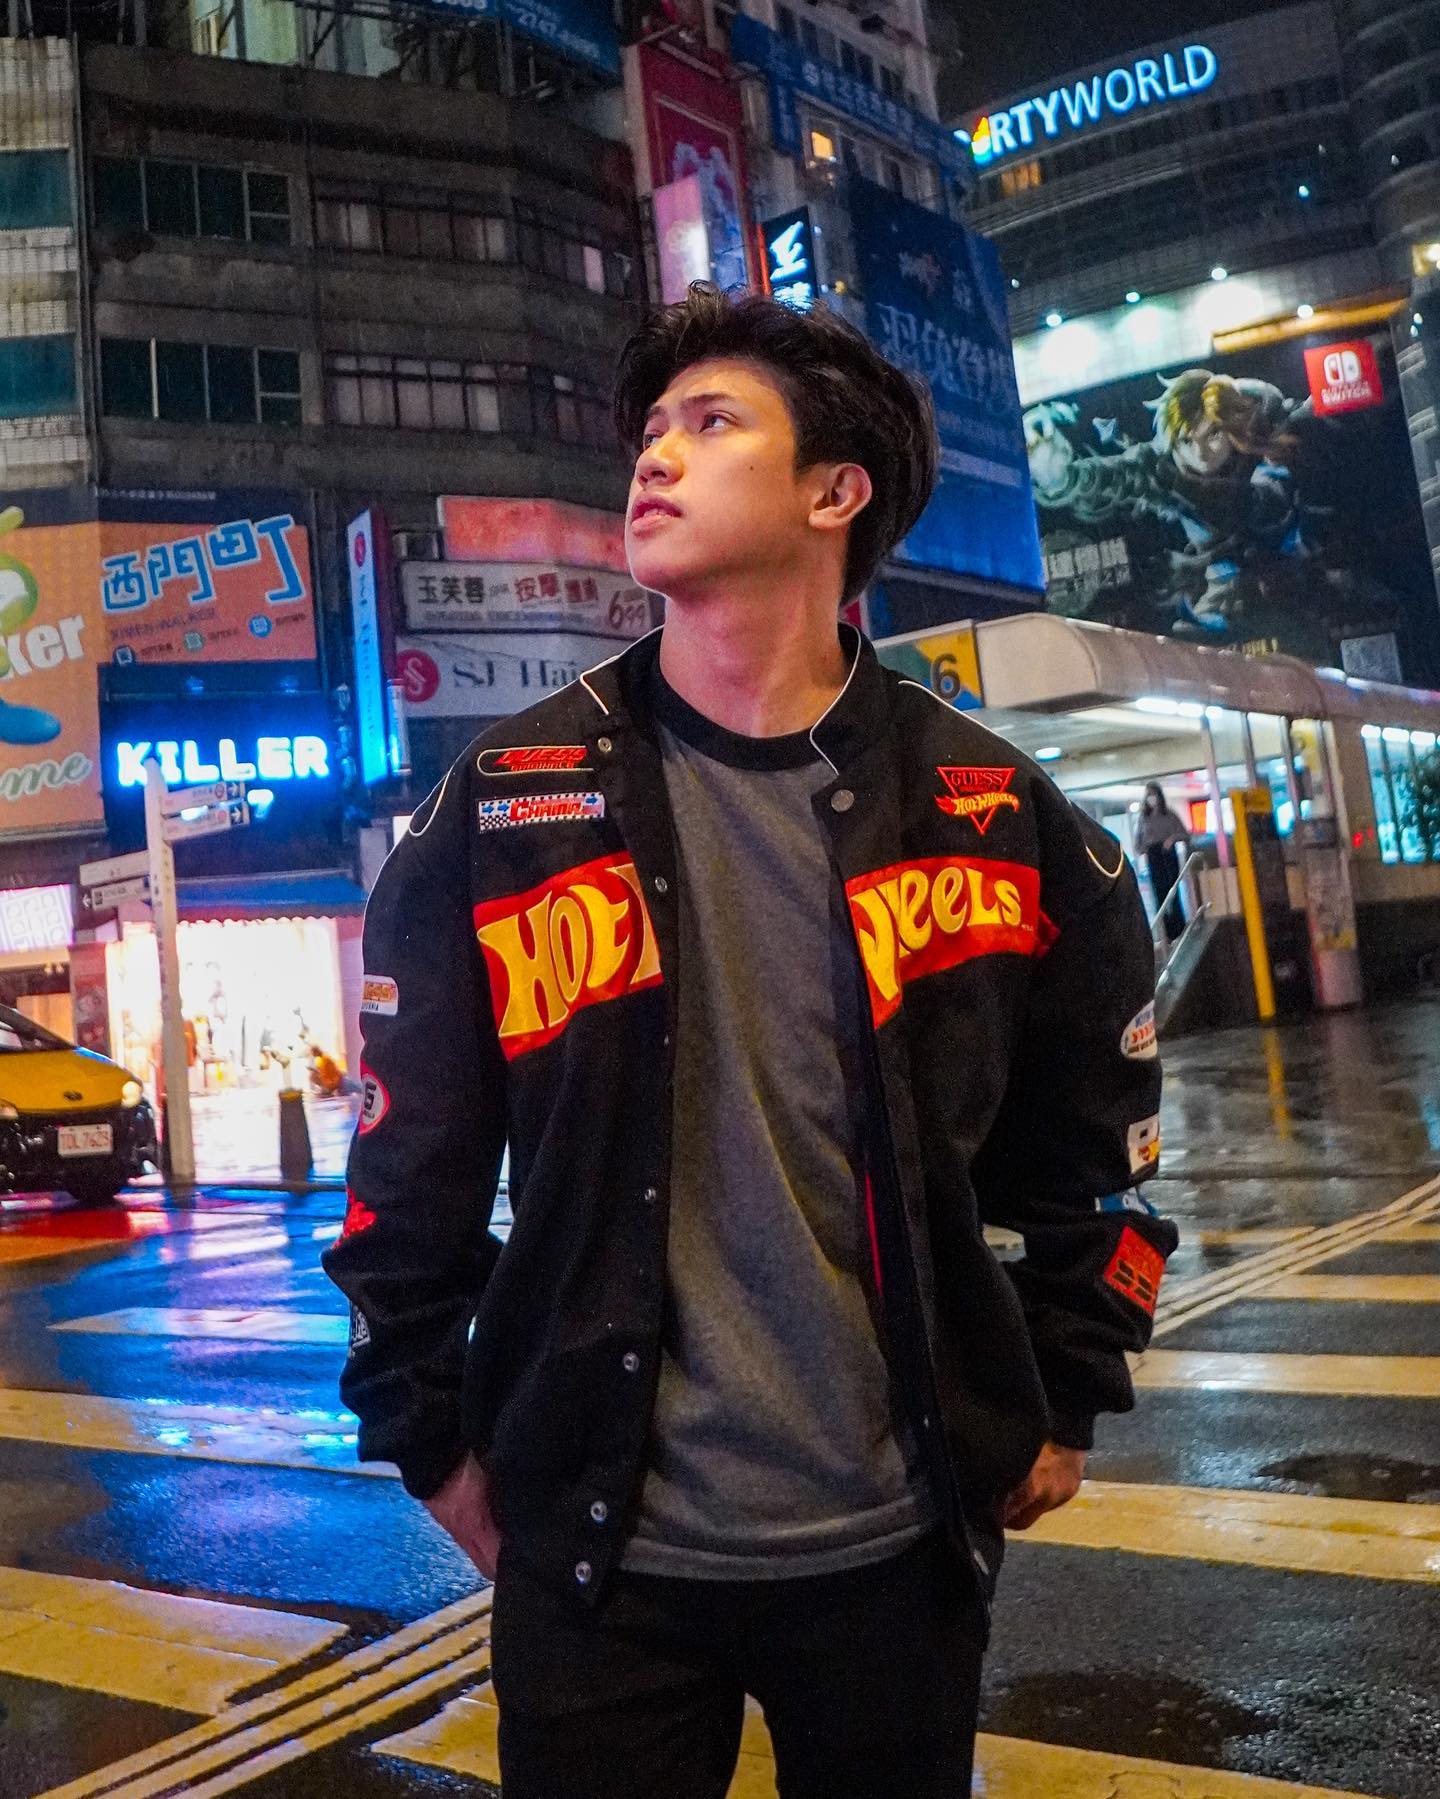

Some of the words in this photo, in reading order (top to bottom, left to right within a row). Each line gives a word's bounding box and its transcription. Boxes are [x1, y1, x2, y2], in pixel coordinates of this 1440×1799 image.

[102, 514, 306, 615] 西門町
[932, 652, 961, 701] 6
[116, 735, 330, 787] KILLER
[950, 772, 1003, 785] GUESS
